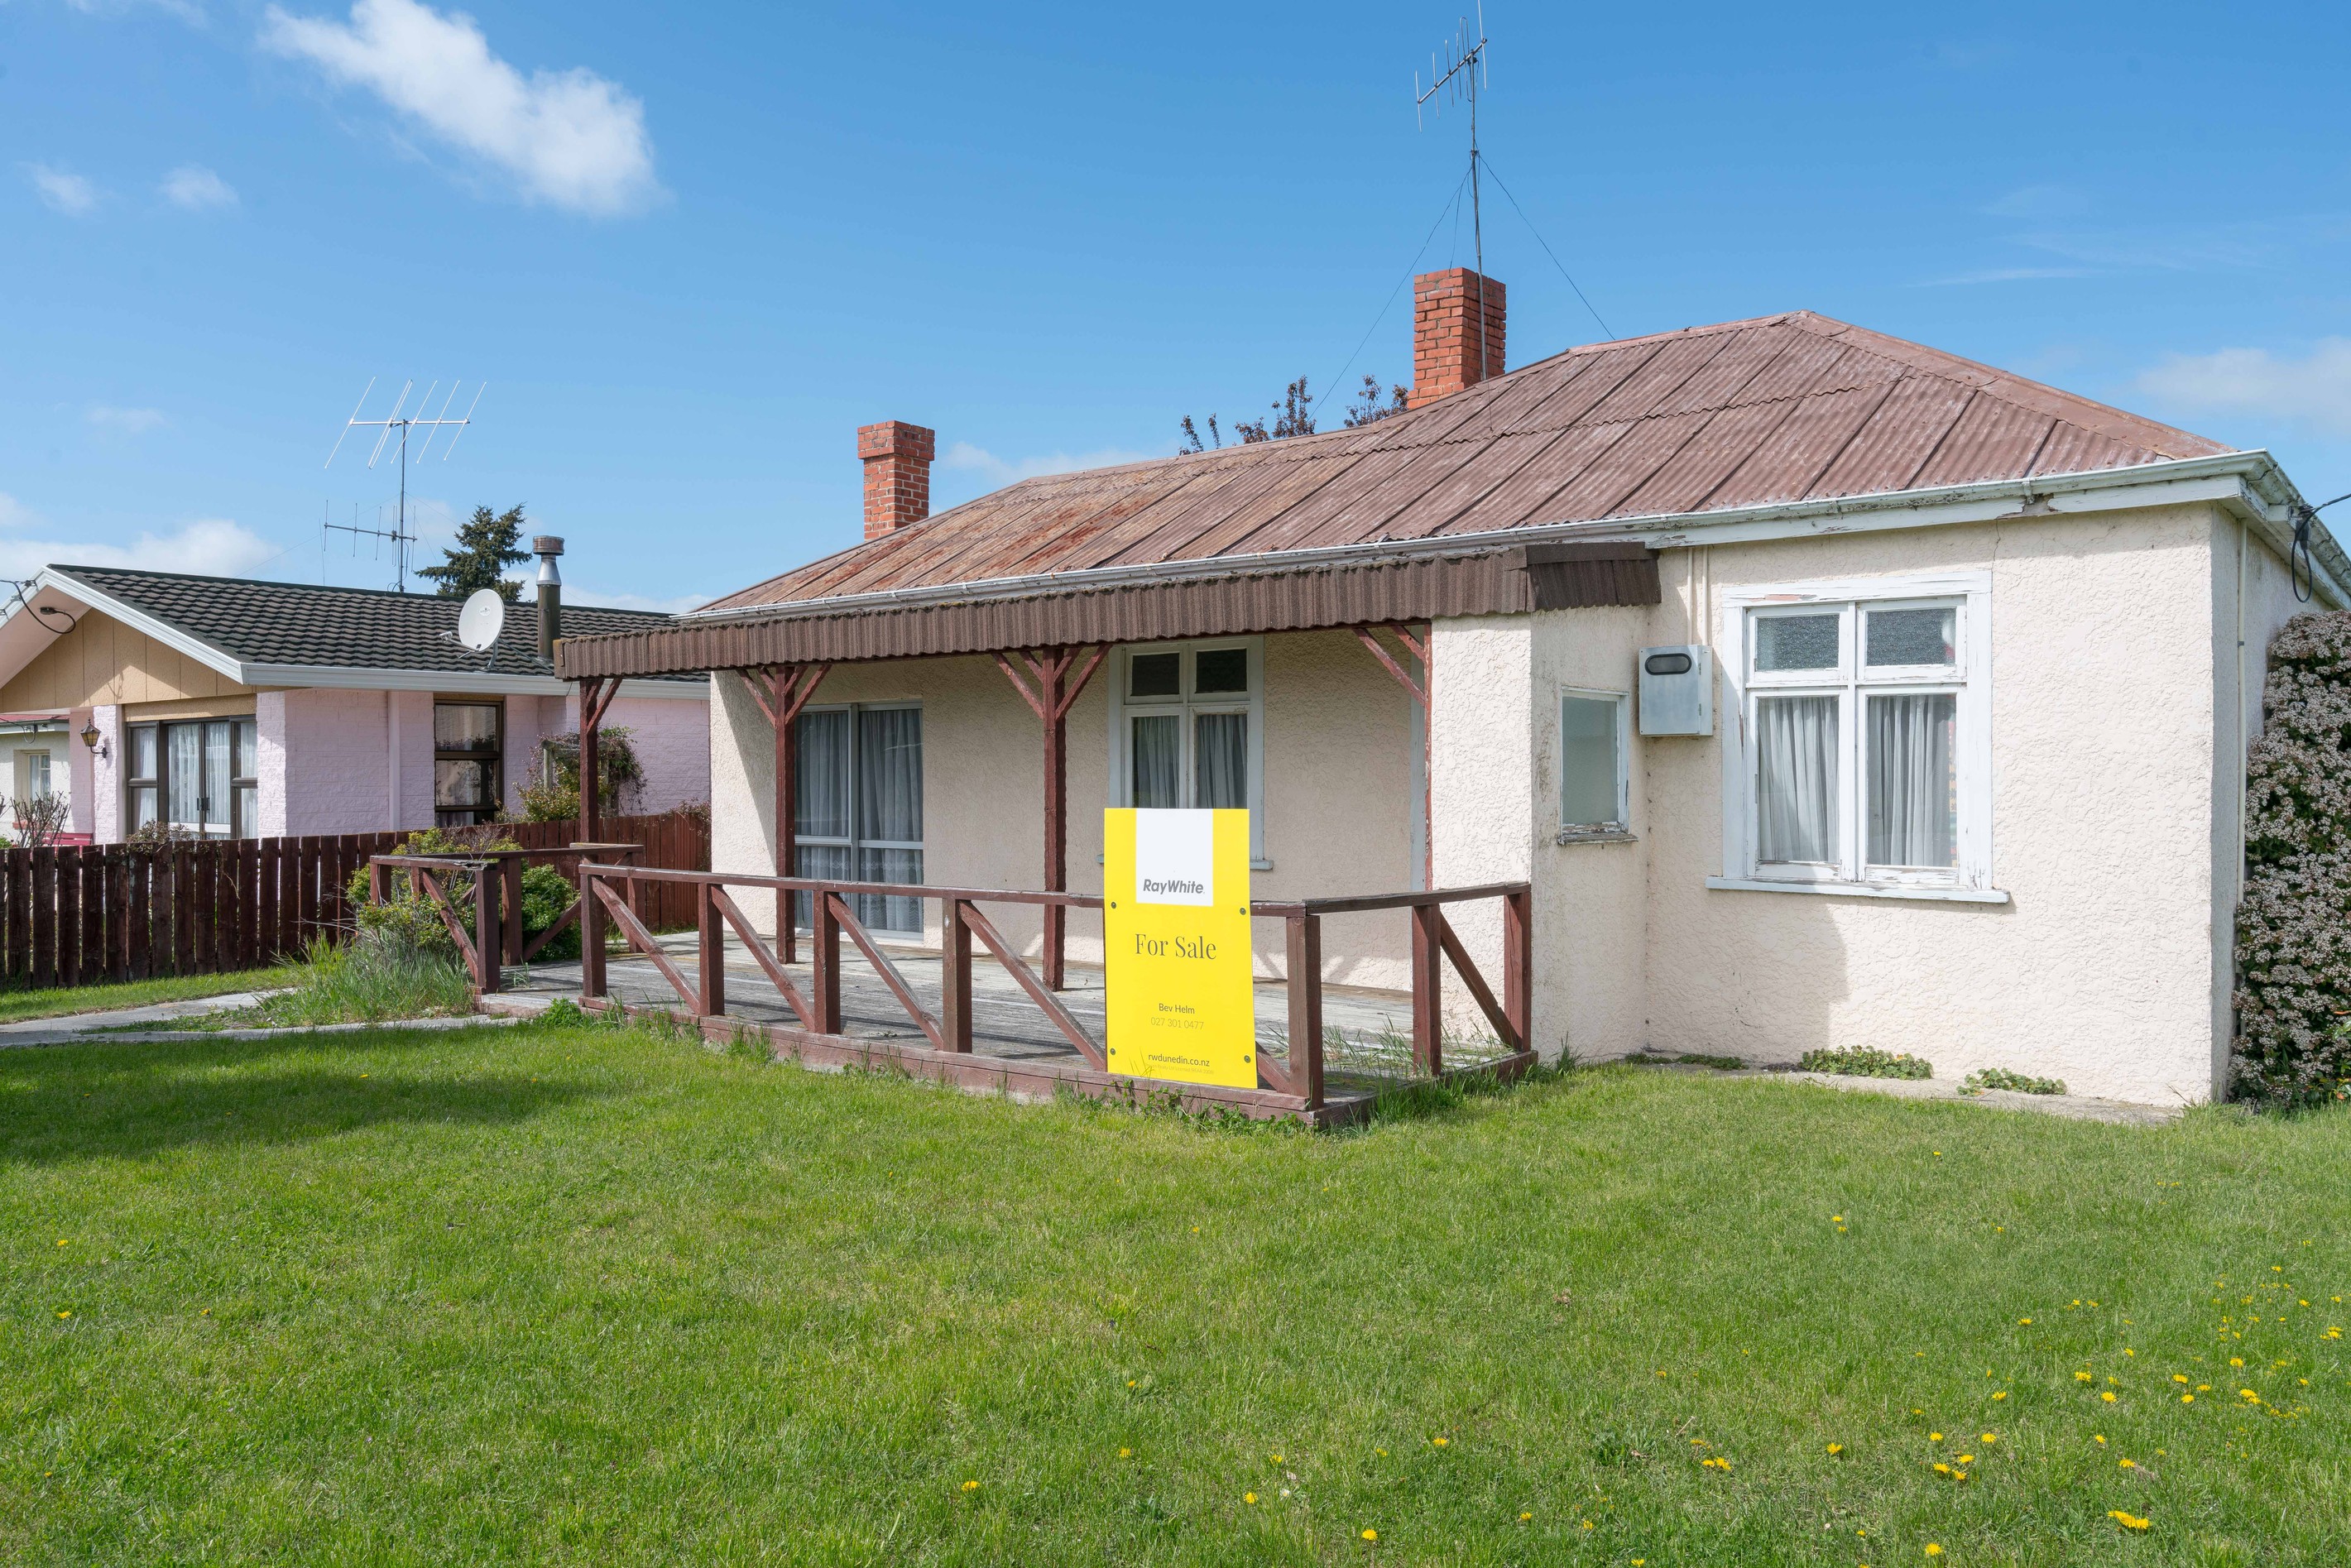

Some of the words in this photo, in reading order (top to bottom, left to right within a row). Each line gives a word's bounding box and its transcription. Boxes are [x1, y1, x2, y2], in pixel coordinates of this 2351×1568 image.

[1143, 879, 1204, 895] RayWhite
[1135, 933, 1168, 957] For
[1175, 935, 1216, 960] Sale
[1159, 1003, 1173, 1012] Bev
[1175, 1004, 1195, 1014] Helm
[1150, 1016, 1165, 1026] 027
[1168, 1018, 1182, 1029] 301
[1183, 1019, 1204, 1030] 0477
[1148, 1053, 1211, 1067] rwdunedin.co.nz
